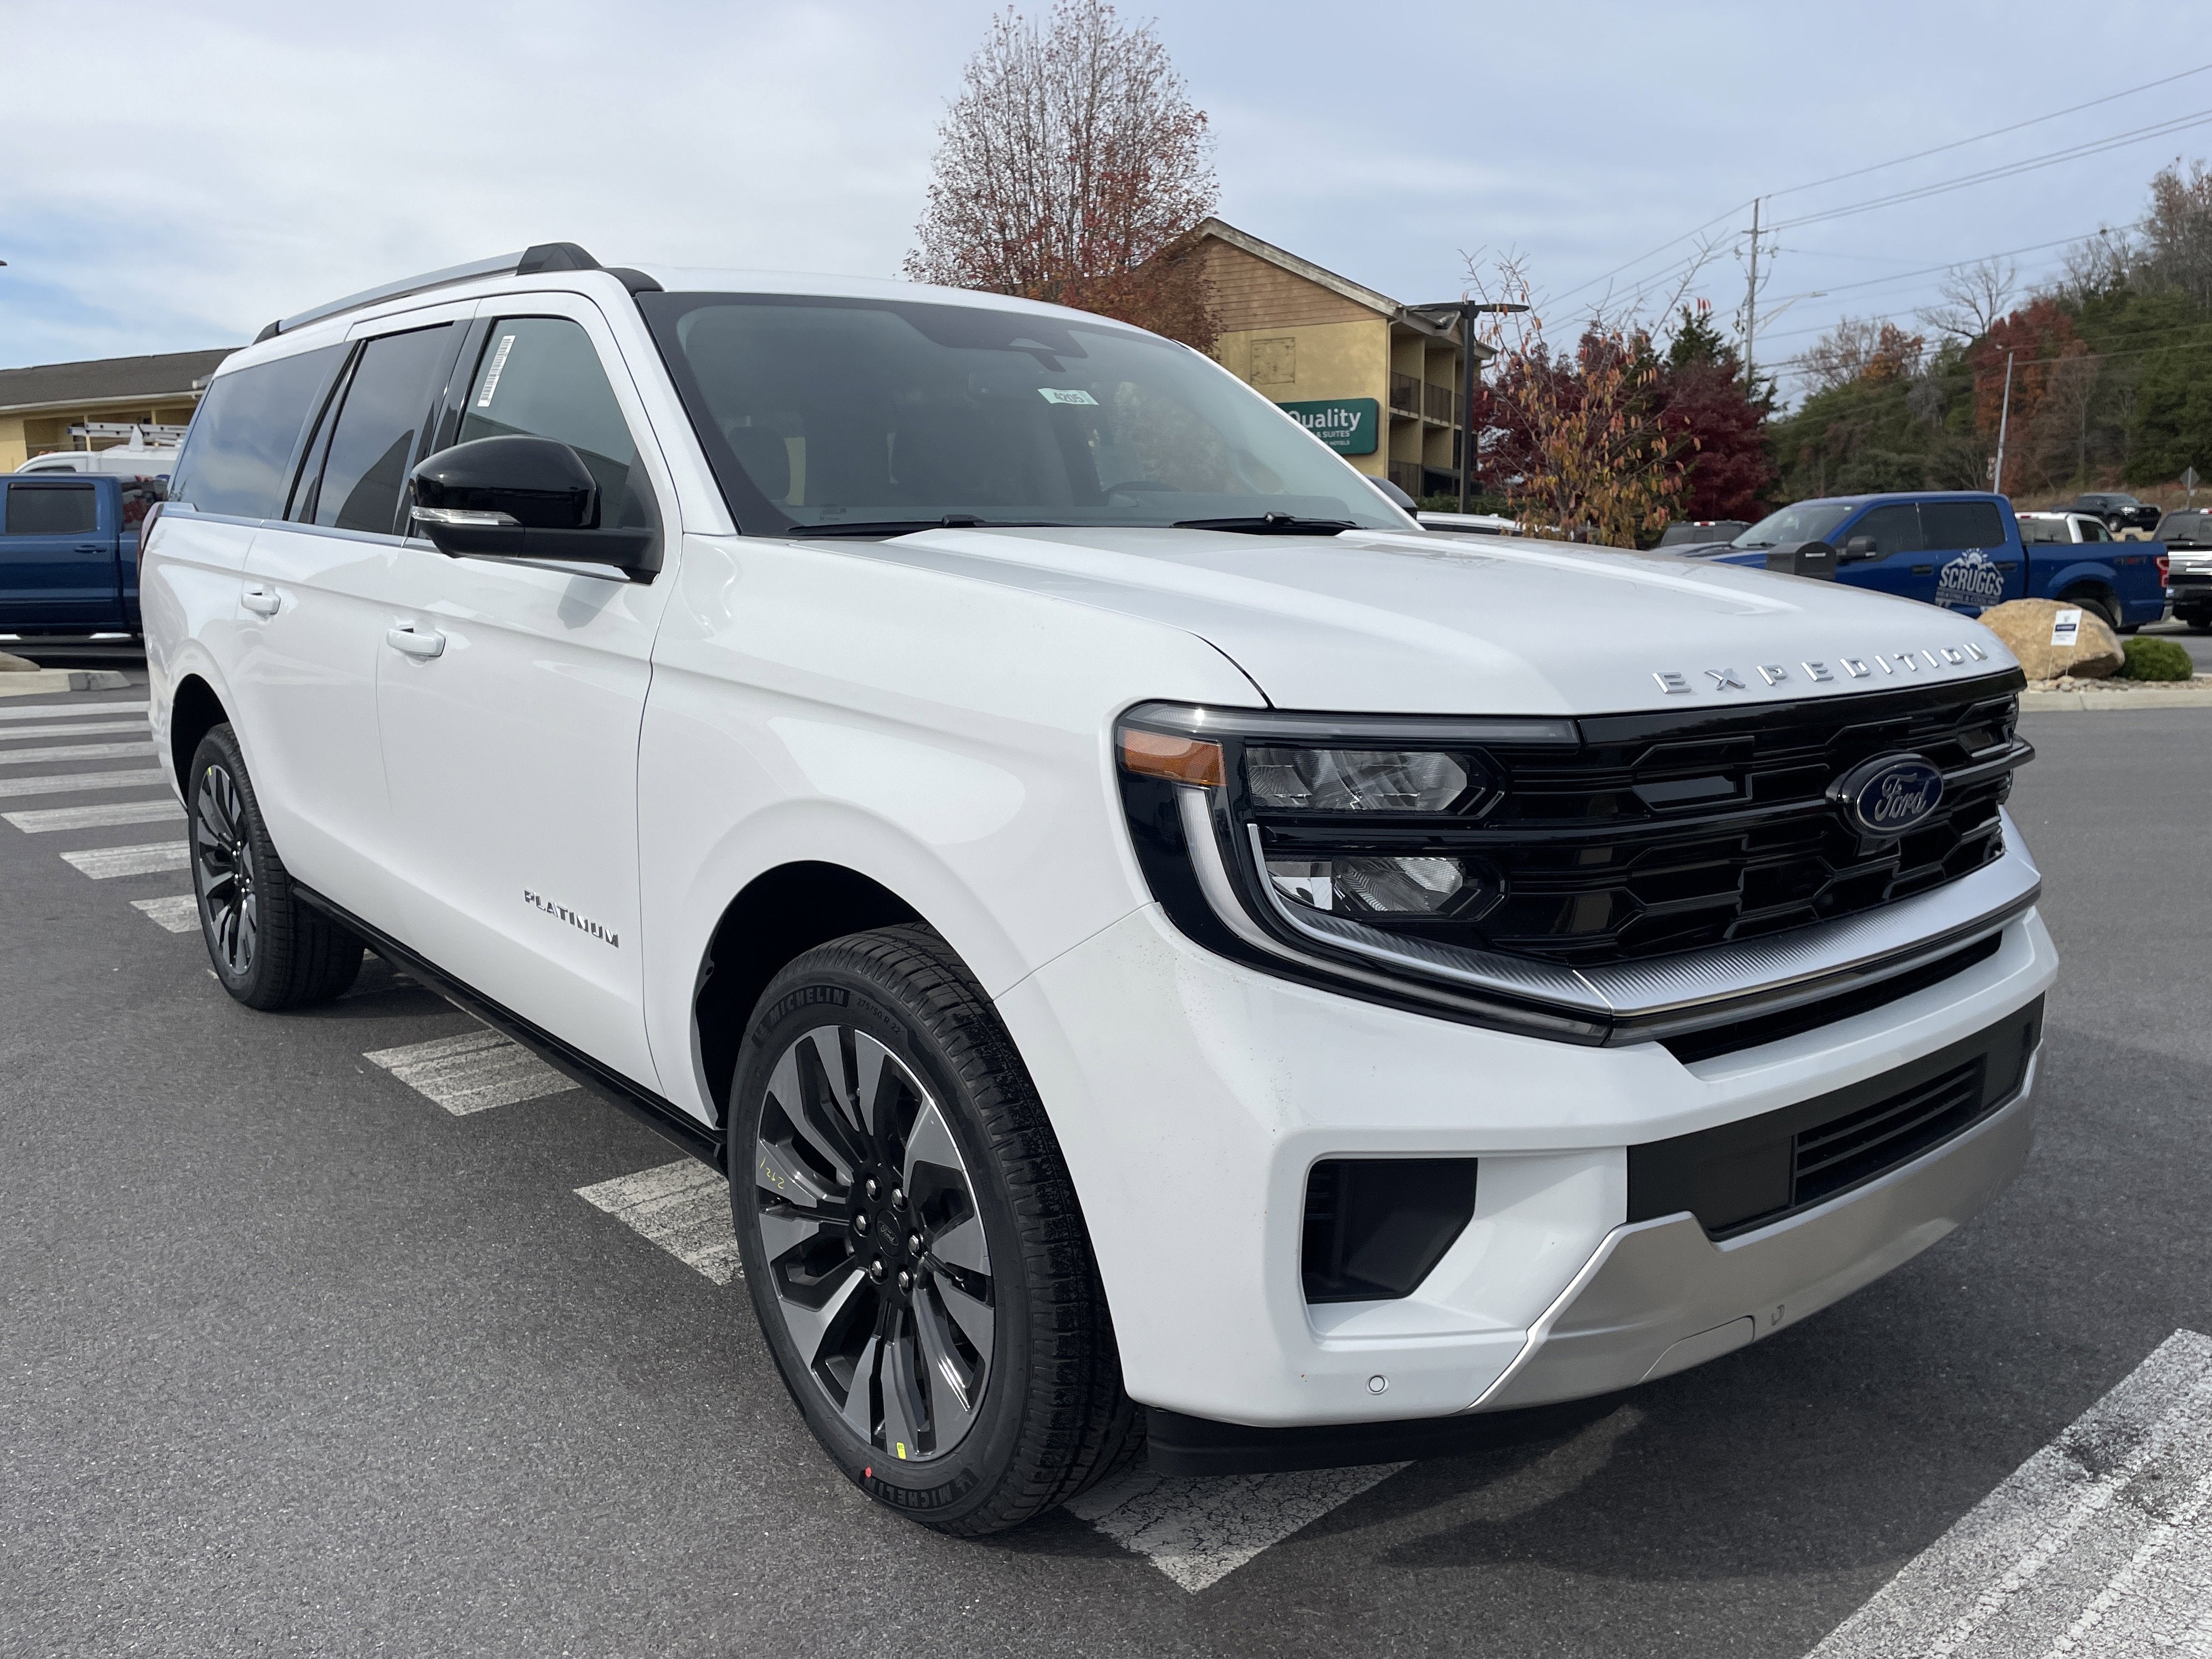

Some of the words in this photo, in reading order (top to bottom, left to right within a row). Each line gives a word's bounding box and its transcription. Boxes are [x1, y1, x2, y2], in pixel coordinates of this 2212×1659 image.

[1939, 567, 2004, 596] SCRUGGS
[1652, 642, 1988, 694] EXPEDITION
[1874, 772, 1927, 821] Ford
[524, 889, 619, 948] PLATINUM
[769, 988, 845, 1024] MICHELIN
[857, 998, 883, 1019] 275/50
[884, 1016, 889, 1024] R
[891, 1023, 901, 1034] 22
[881, 1224, 895, 1243] Ford
[864, 1477, 953, 1508] MICHELIN
